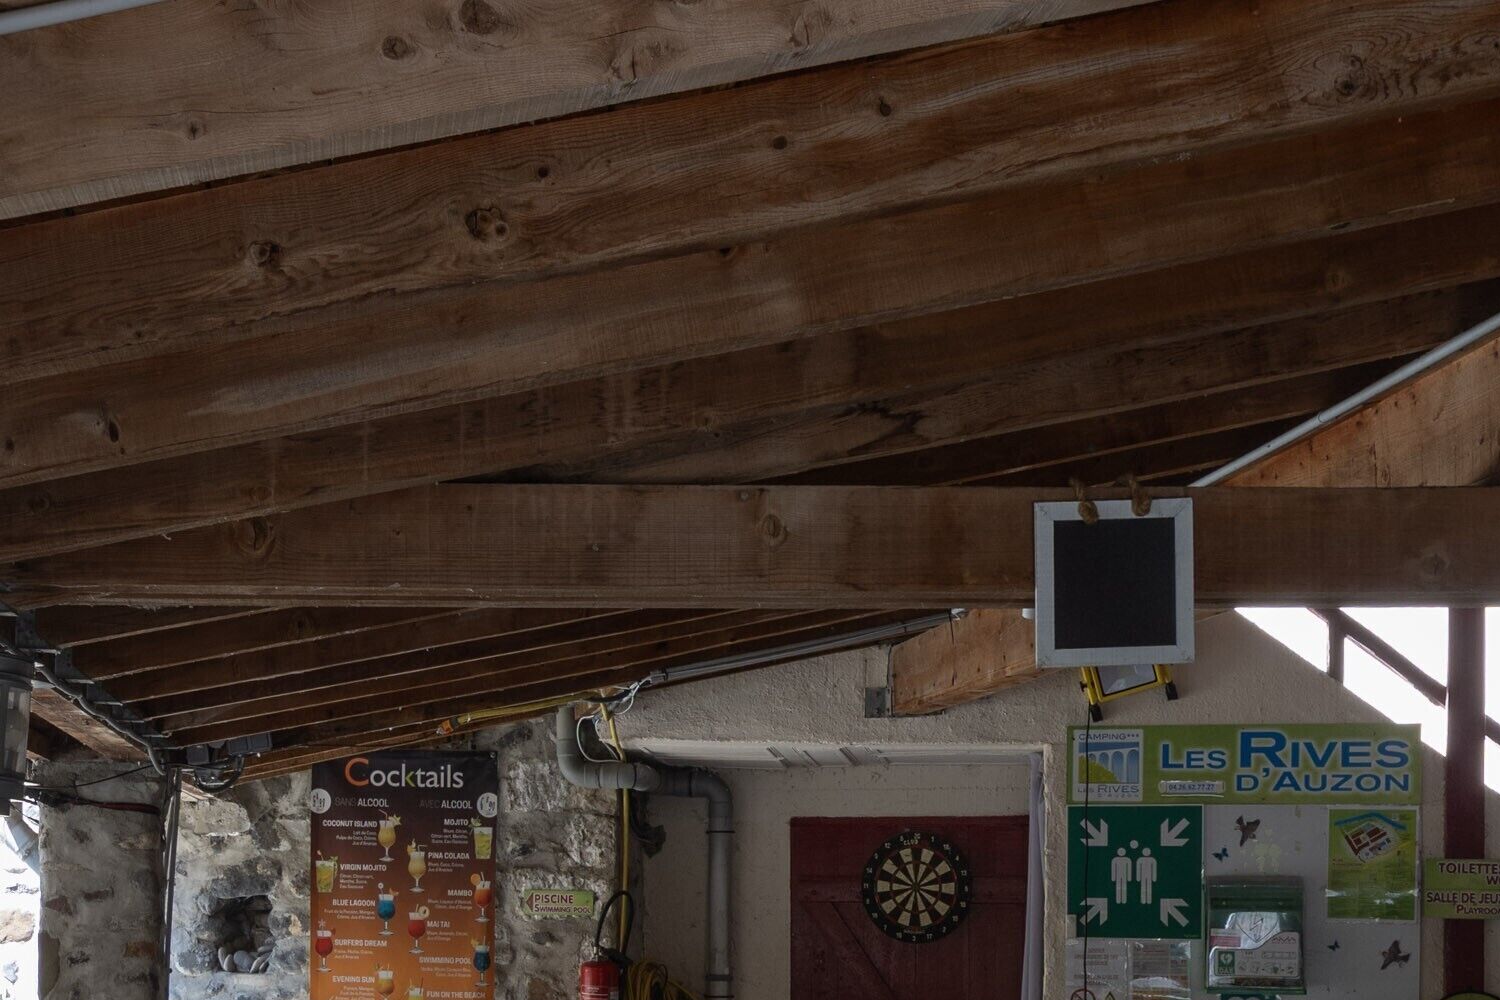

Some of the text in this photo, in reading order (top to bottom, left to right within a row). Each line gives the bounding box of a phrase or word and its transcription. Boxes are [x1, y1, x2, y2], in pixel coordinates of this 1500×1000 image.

[1162, 731, 1409, 769] LES RIVES
[343, 757, 464, 788] Cocktails
[1236, 767, 1409, 792] D'AUZON
[1097, 784, 1140, 793] RIVES
[357, 798, 389, 808] ALCOOL
[441, 800, 473, 809] ALCOOL
[322, 819, 378, 828] COCONUT ISLAND
[443, 818, 469, 826] MOJITO
[427, 852, 470, 860] PINA COLADA
[340, 863, 361, 871] VIRGIN
[447, 889, 473, 897] MAMBO
[332, 898, 376, 907] BLUE LAGOON
[534, 894, 574, 904] PISCINE
[1426, 892, 1458, 903] SALLE
[1461, 893, 1475, 904] DE
[464, 991, 486, 999] BEACH
